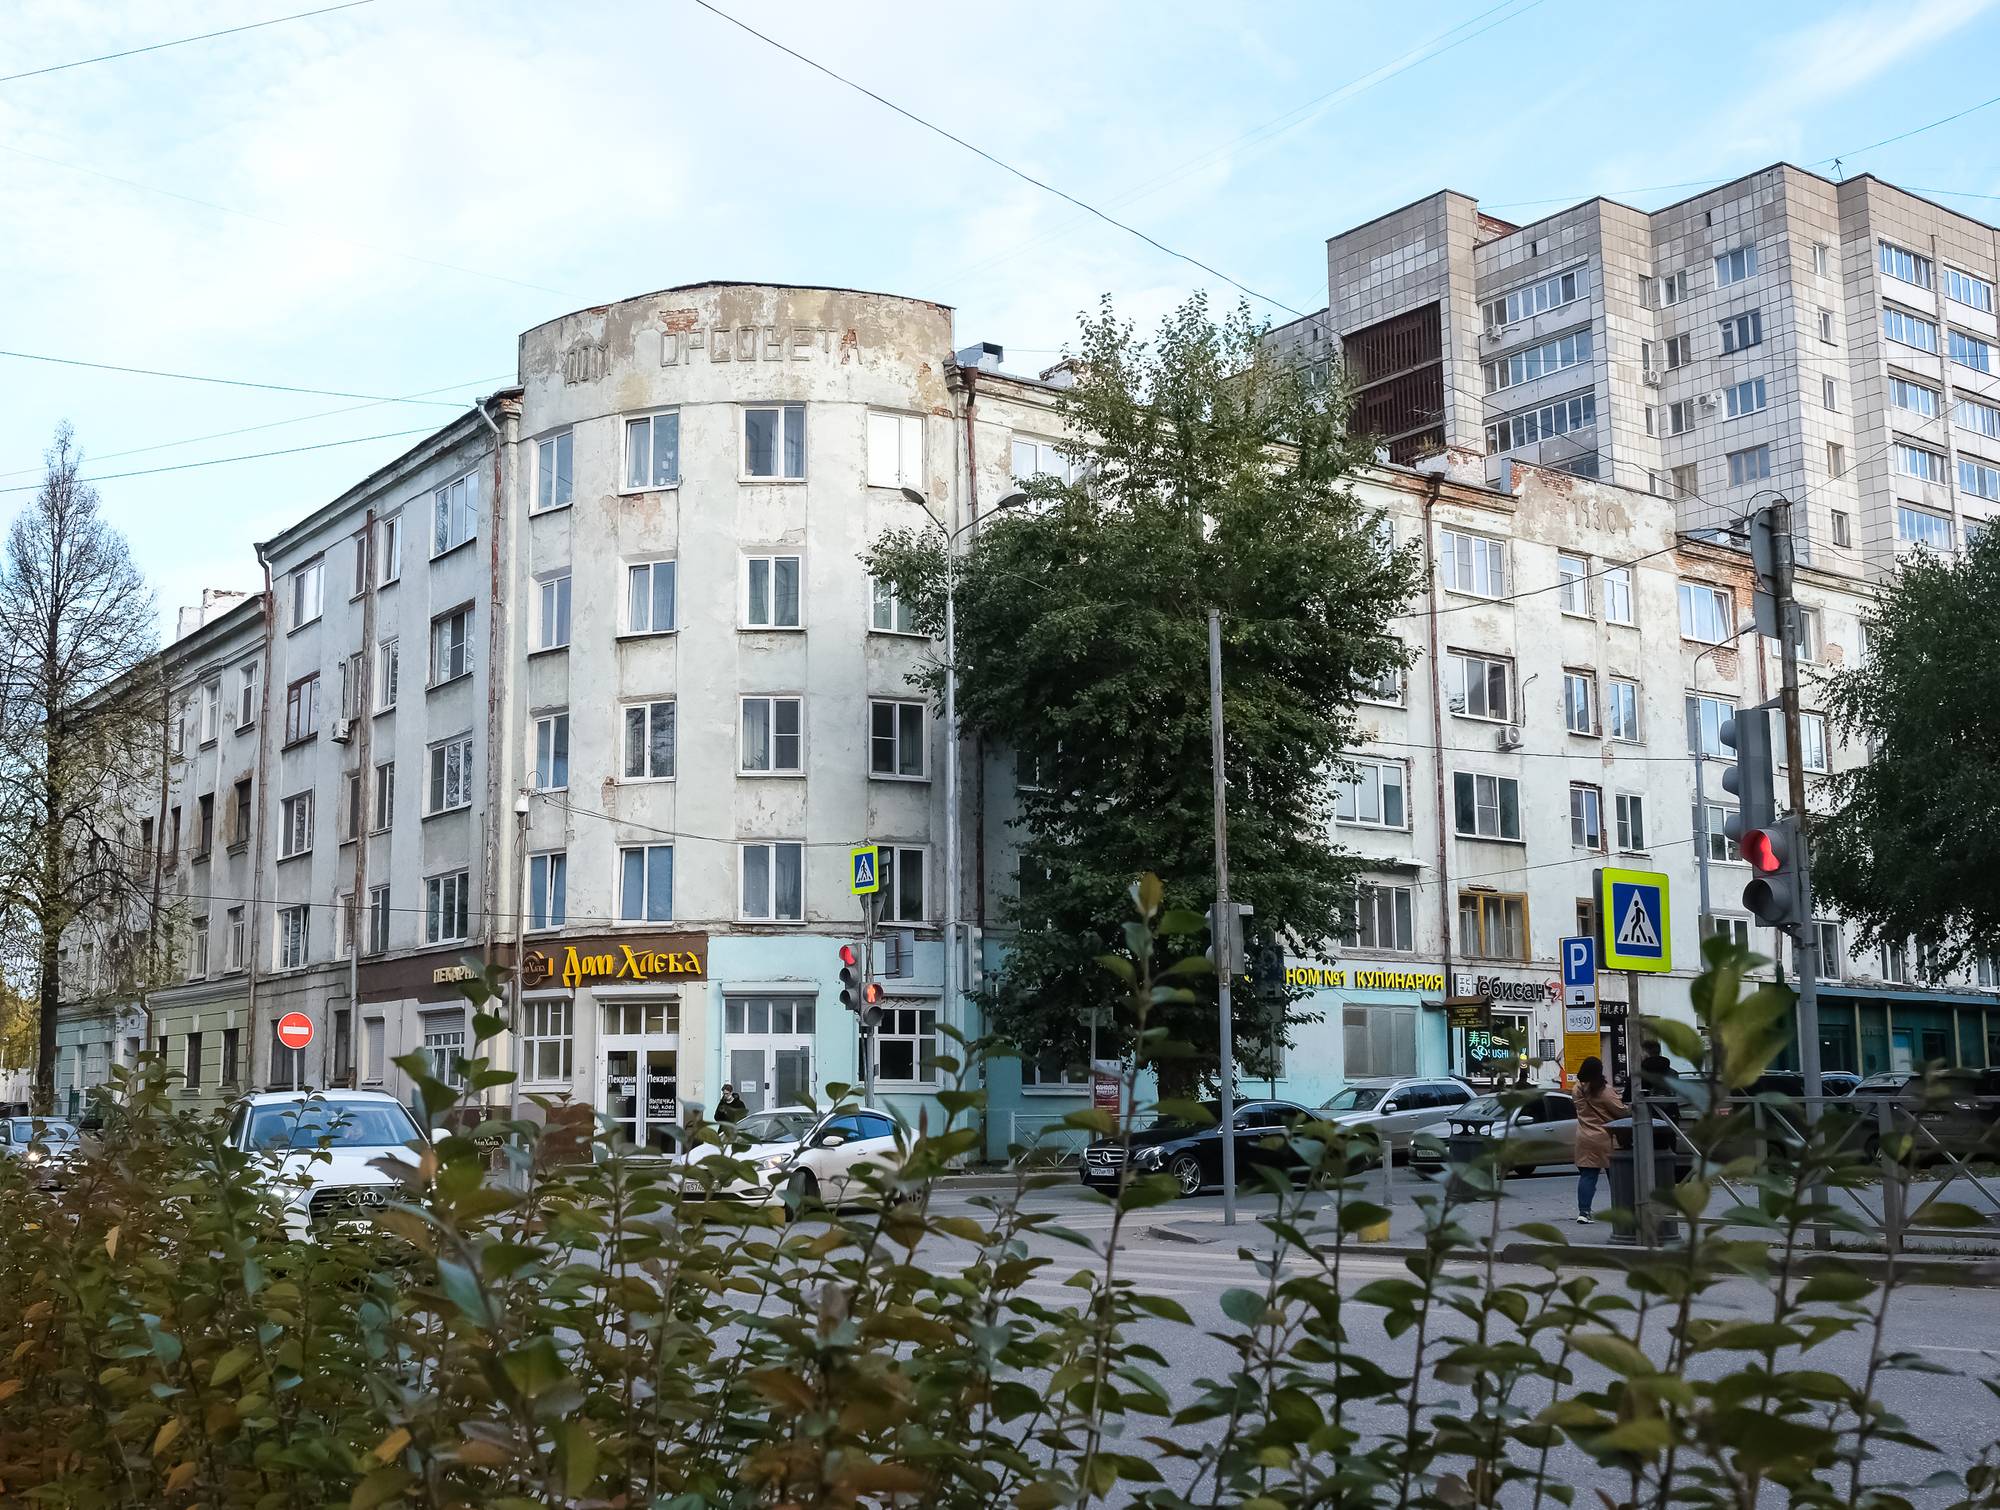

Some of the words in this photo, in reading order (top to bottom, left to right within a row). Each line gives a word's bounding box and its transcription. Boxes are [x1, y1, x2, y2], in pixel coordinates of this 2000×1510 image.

[562, 946, 613, 987] Дом
[616, 944, 702, 979] Хлеба
[1286, 967, 1320, 987] НОМ
[1324, 969, 1346, 987] №1
[1356, 971, 1444, 991] КУЛИНАРИЯ
[1583, 1016, 1591, 1024] 20
[1468, 1030, 1490, 1047] 寿司
[647, 1074, 676, 1085] Пекарня
